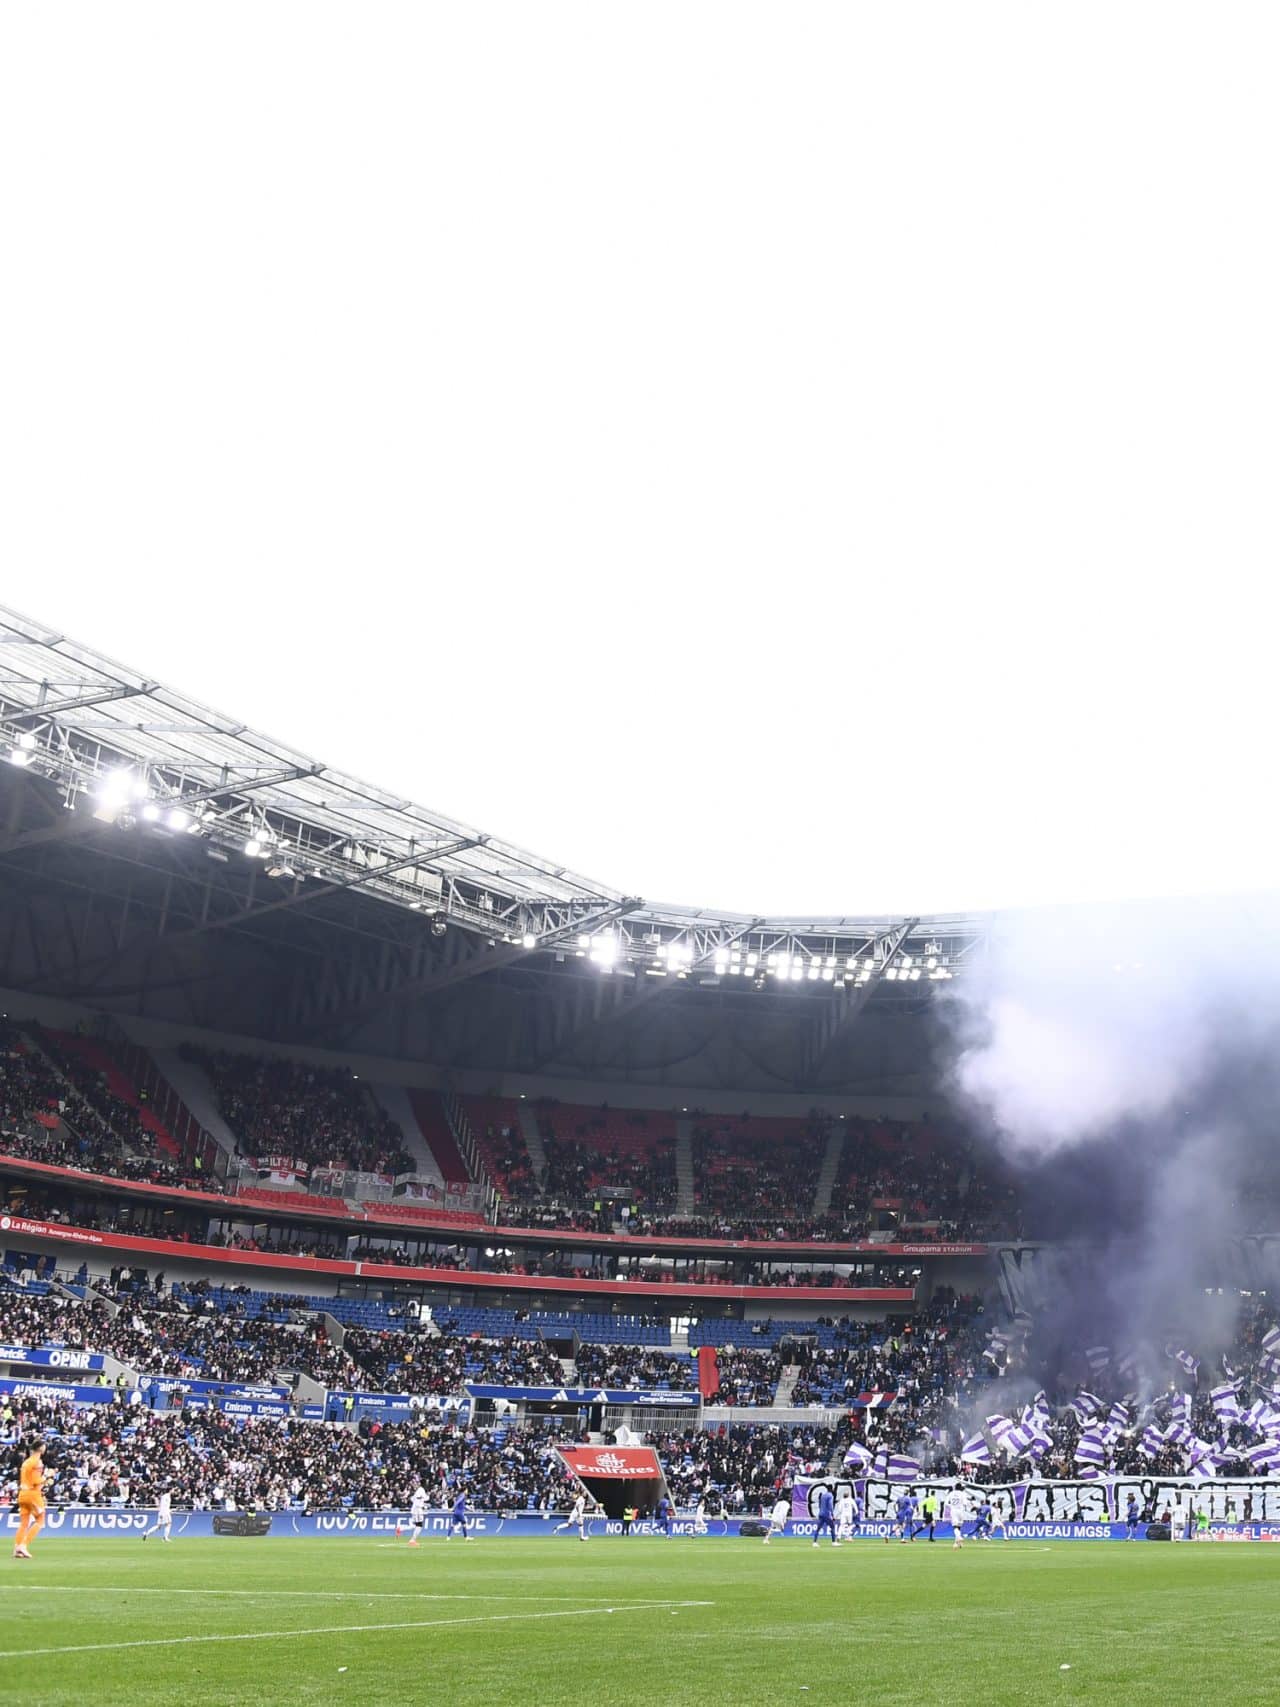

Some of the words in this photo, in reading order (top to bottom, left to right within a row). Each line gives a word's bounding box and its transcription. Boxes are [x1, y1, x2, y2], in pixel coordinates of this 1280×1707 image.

[11, 1220, 21, 1229] La
[21, 1221, 47, 1233] Région
[903, 1244, 941, 1253] Groupama
[225, 1402, 253, 1412] Emirates
[257, 1404, 285, 1415] Emirates
[575, 1463, 655, 1475] Emirates
[1008, 1525, 1070, 1538] NOUVEAU
[1073, 1525, 1111, 1538] MGS5
